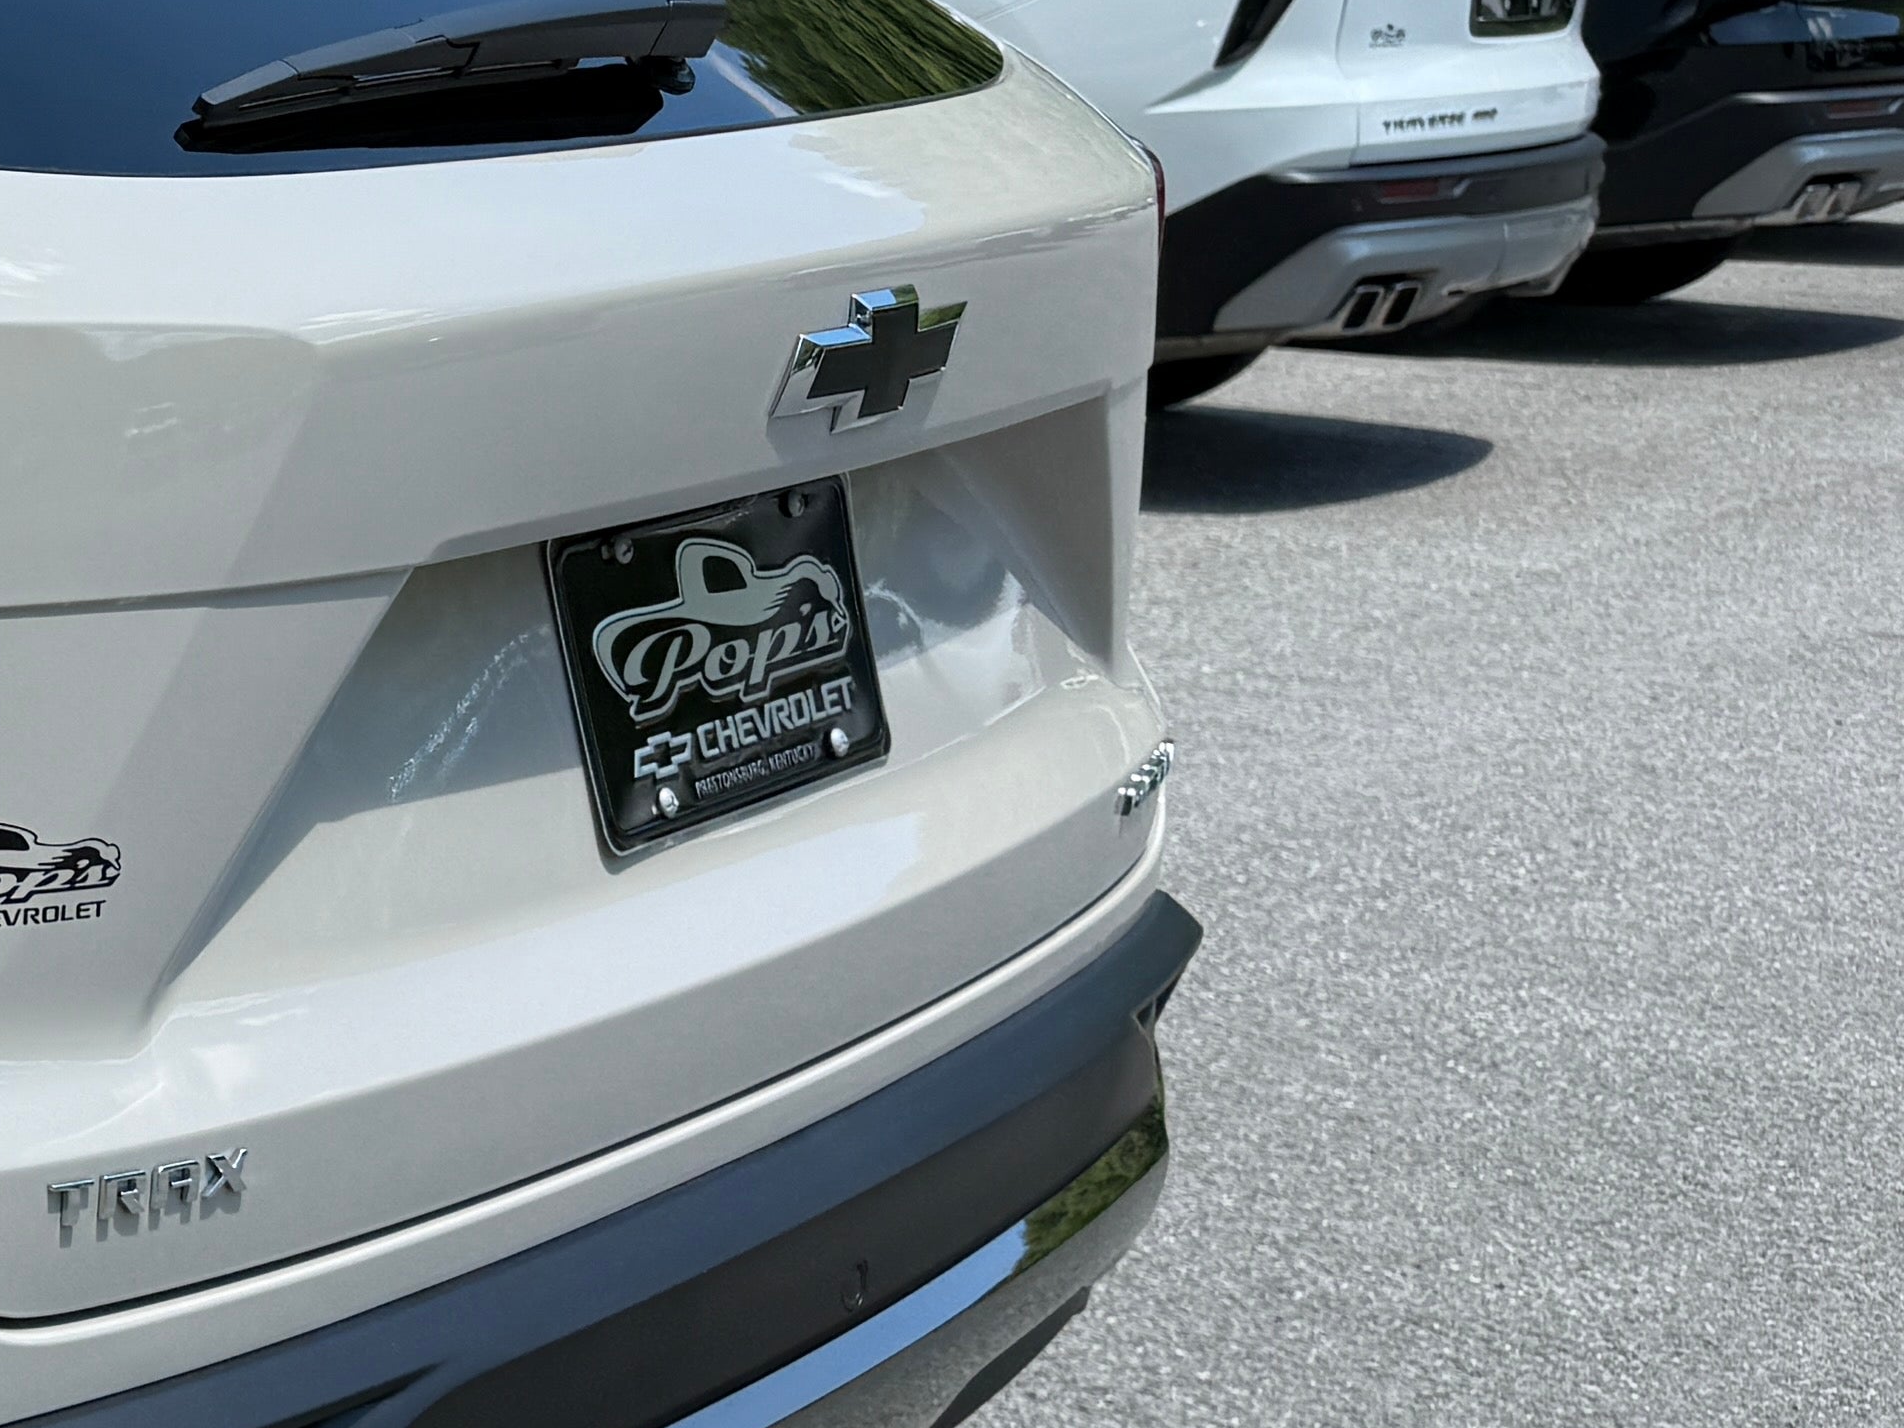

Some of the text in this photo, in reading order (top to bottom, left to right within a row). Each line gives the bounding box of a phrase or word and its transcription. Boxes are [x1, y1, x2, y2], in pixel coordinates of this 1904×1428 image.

[695, 675, 854, 759] CHEVROLET
[768, 742, 818, 771] KENTUCKY
[46, 1148, 248, 1227] TRAX
